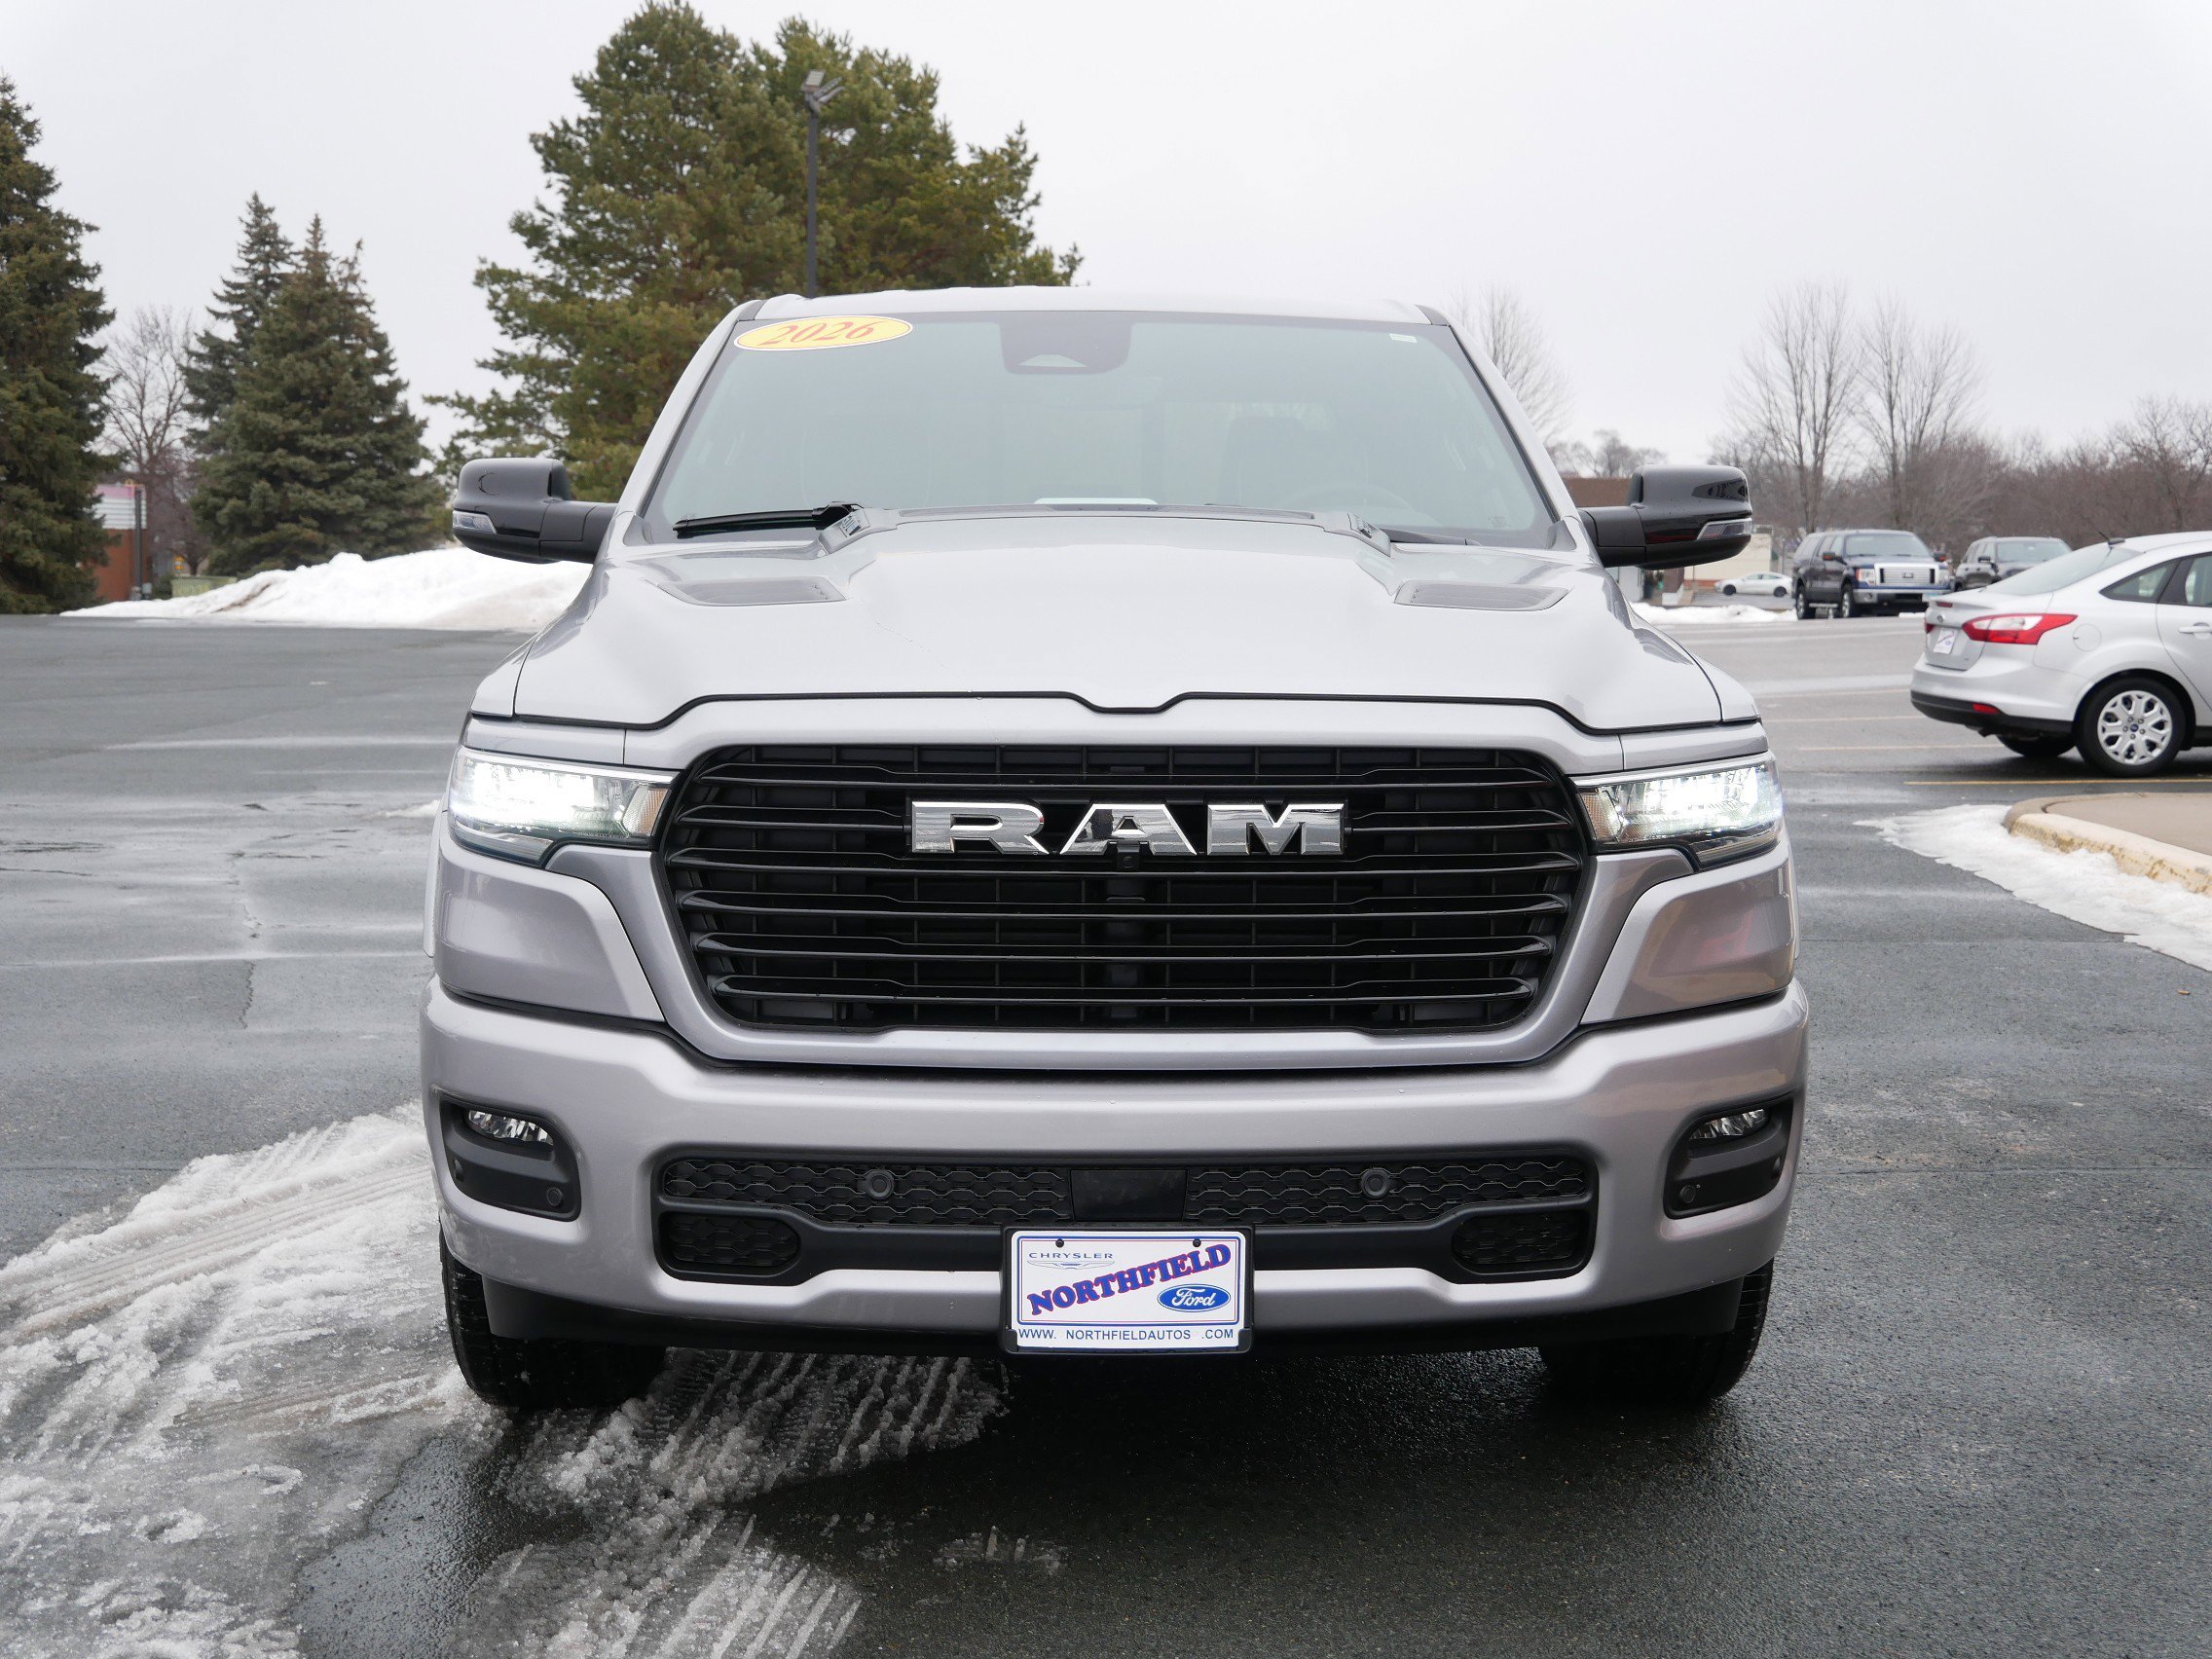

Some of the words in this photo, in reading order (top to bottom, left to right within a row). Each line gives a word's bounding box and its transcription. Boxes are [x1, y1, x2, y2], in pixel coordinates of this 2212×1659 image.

[757, 320, 886, 347] 2026
[911, 801, 1347, 857] RAM
[1026, 1243, 1232, 1316] NORTHFIELD
[1170, 1287, 1216, 1308] Ford
[1018, 1329, 1057, 1340] WWW.
[1066, 1329, 1191, 1341] NORTHFIELDAUTOS
[1201, 1328, 1234, 1340] .COM
